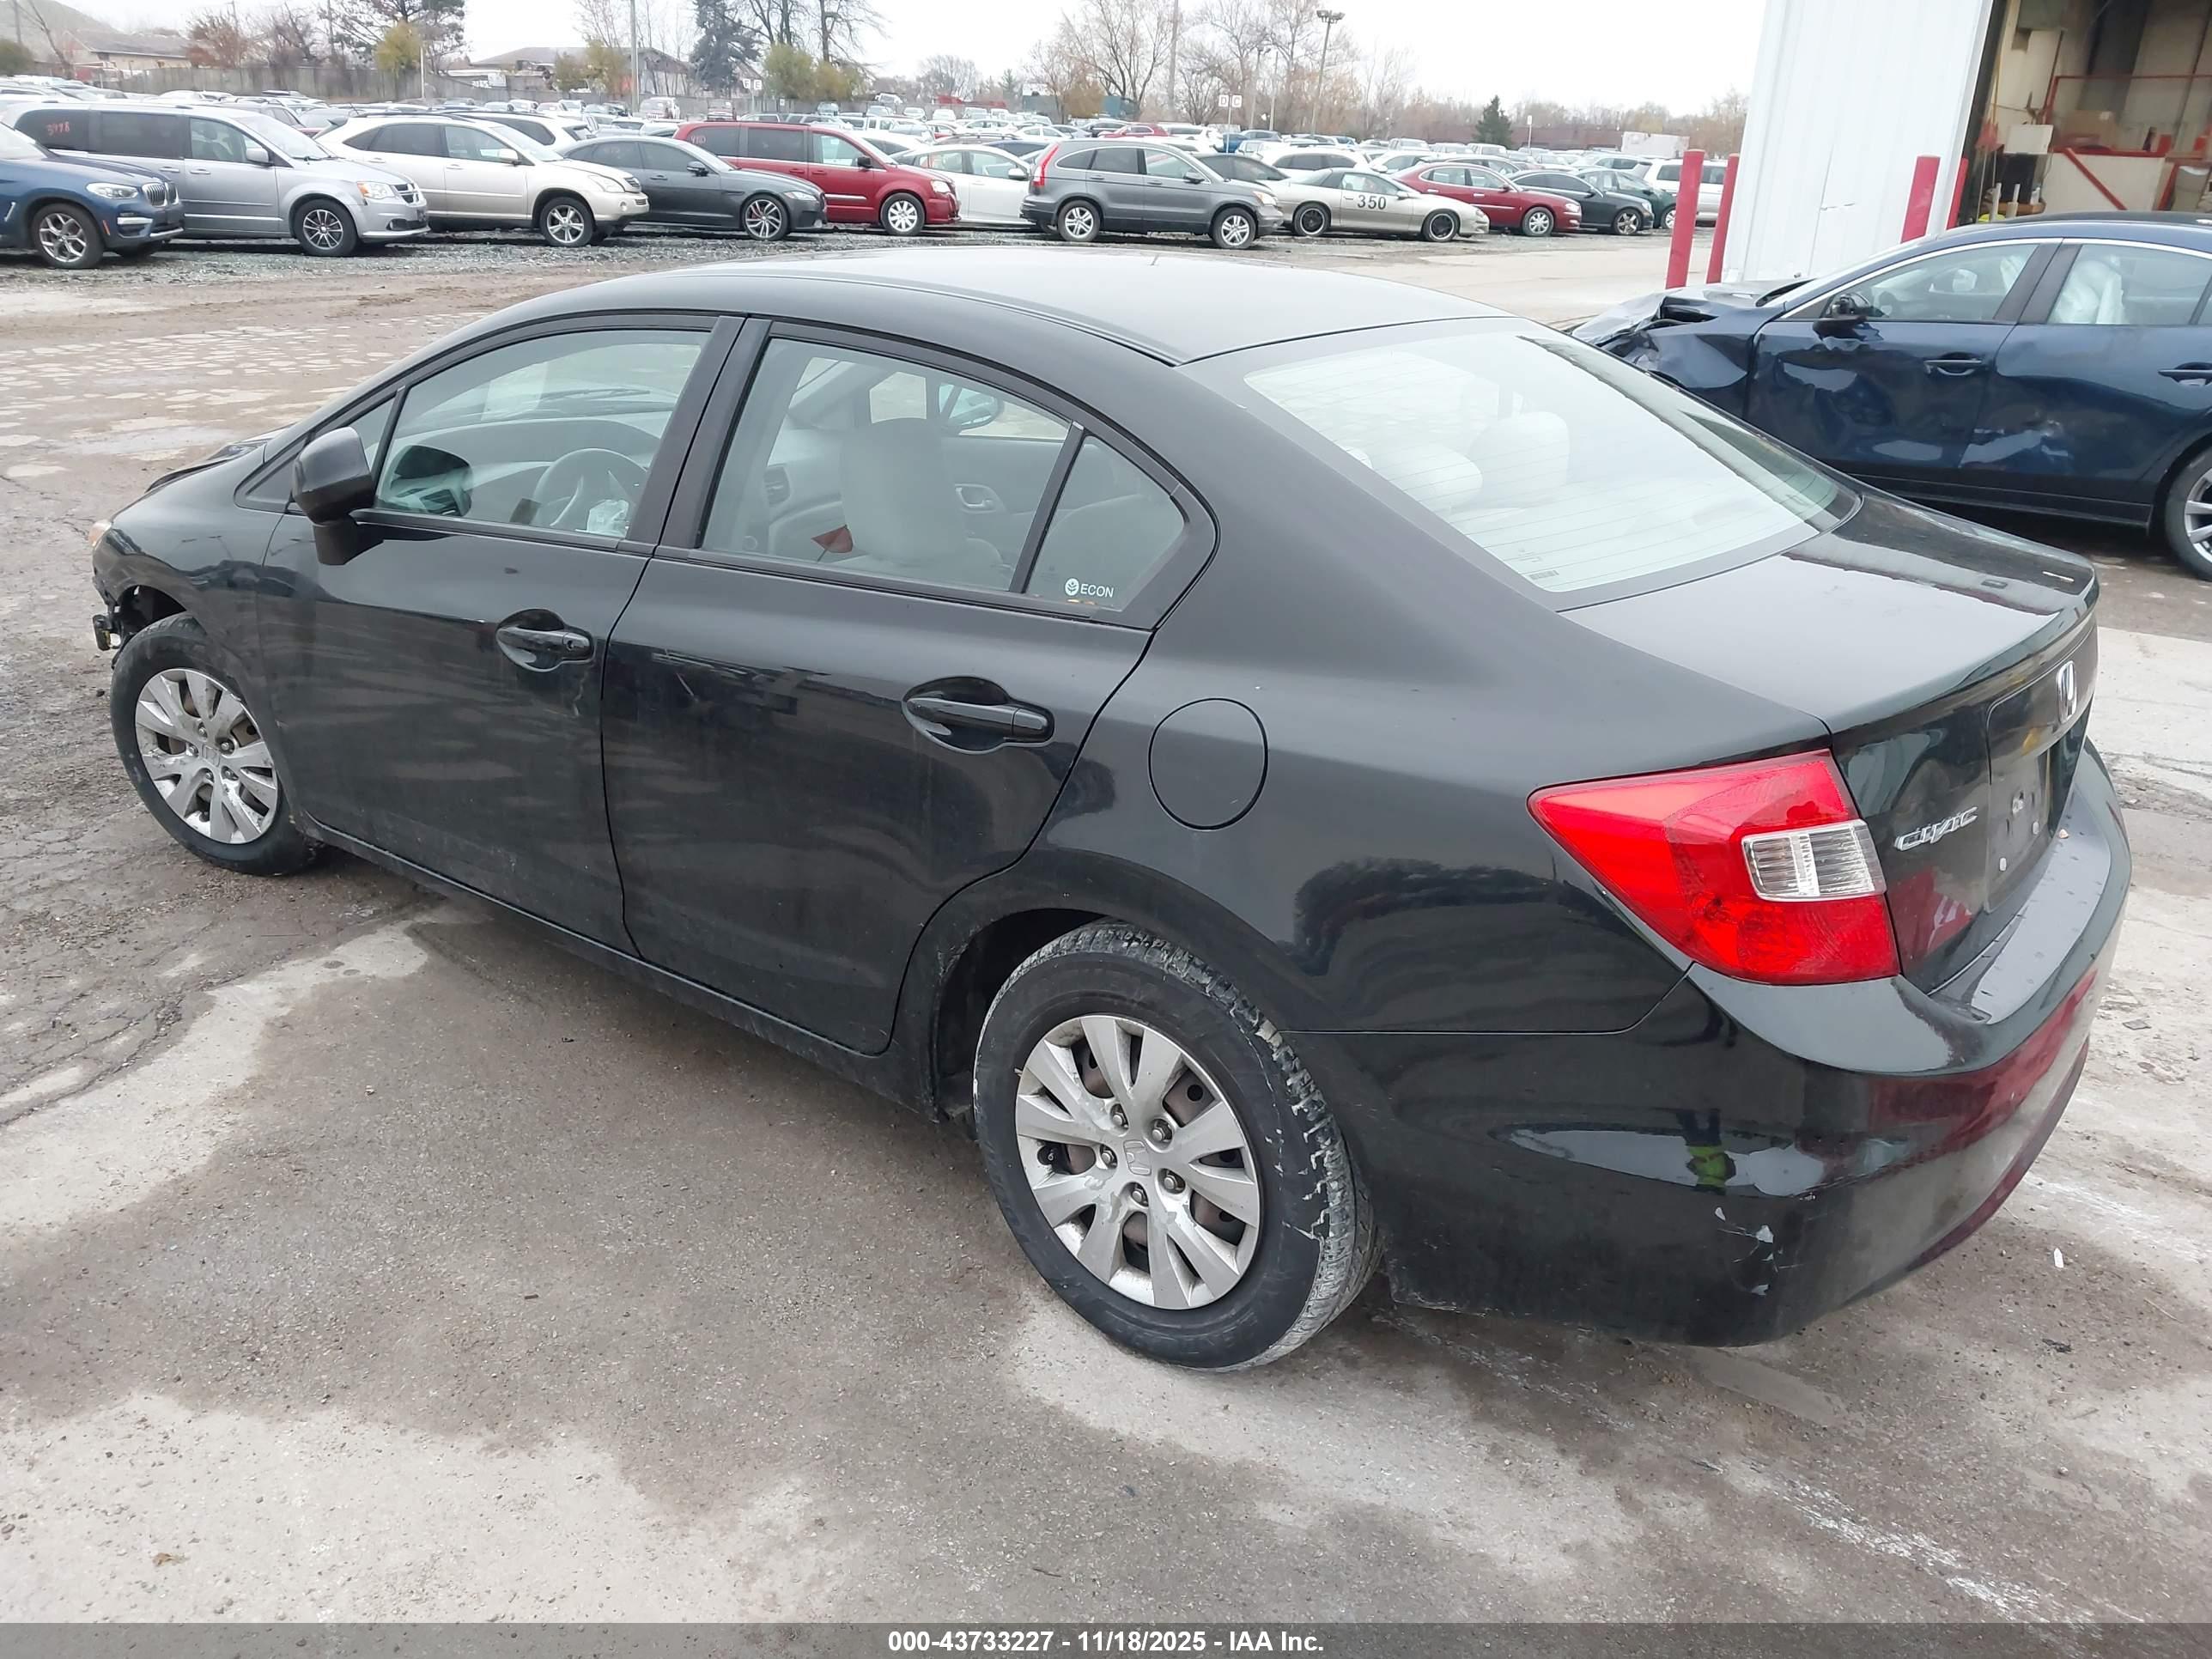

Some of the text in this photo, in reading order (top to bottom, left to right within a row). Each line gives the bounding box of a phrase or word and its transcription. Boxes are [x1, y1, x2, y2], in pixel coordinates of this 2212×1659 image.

[1357, 194, 1387, 210] 350
[1080, 583, 1114, 598] ECON
[1893, 806, 1978, 851] CIVIC
